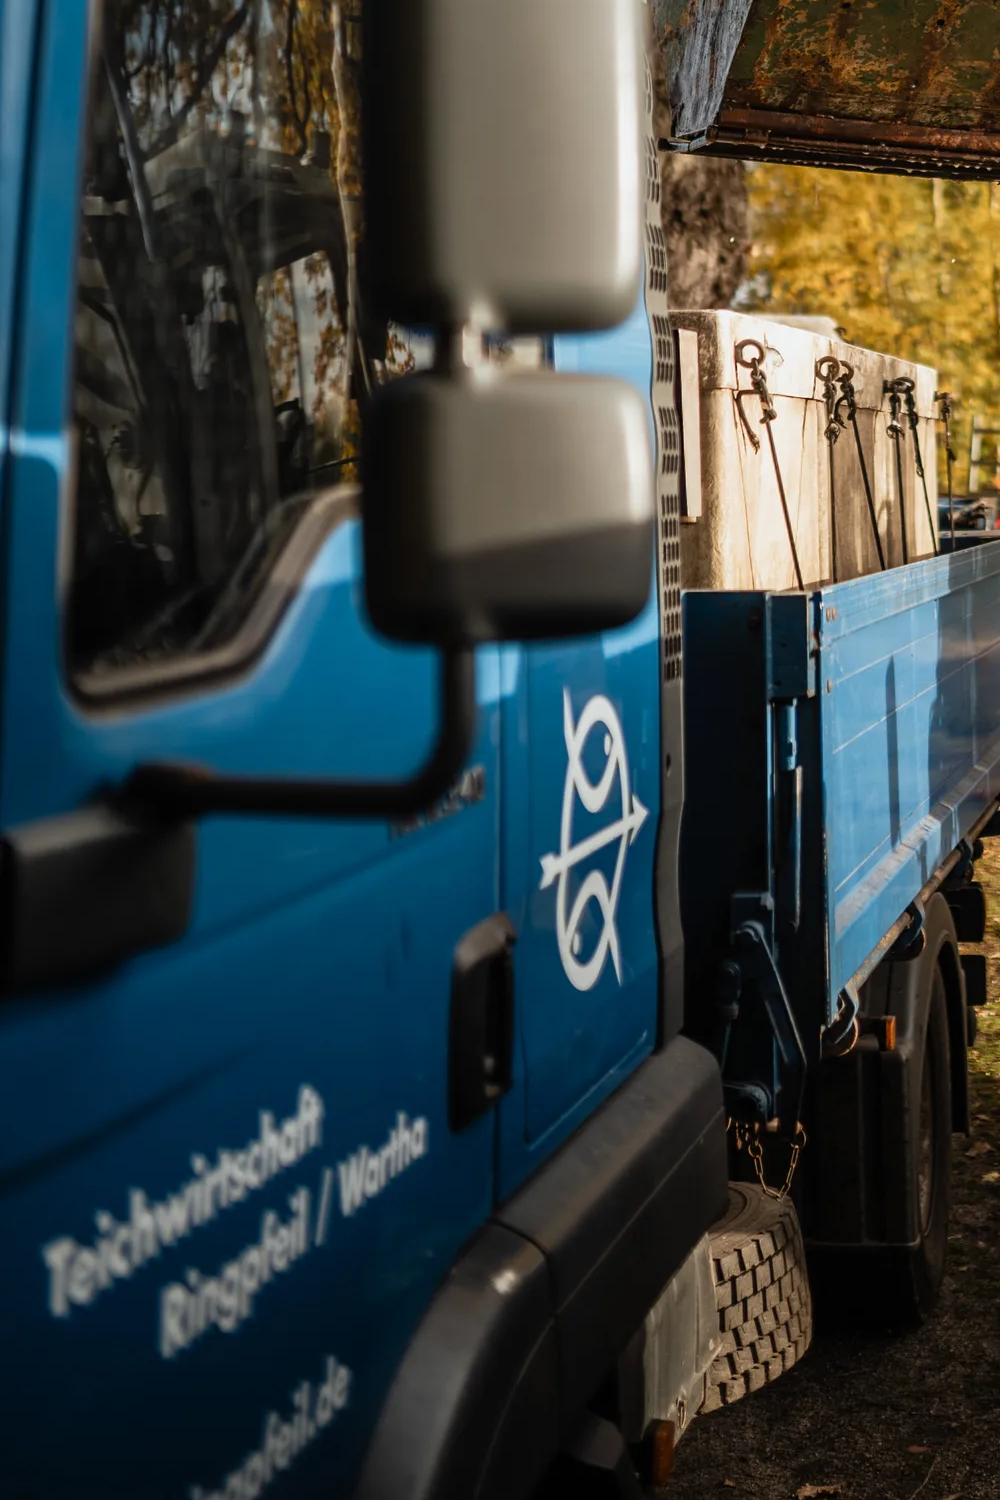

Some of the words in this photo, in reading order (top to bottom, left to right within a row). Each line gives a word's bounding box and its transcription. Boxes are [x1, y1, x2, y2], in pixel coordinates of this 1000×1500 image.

[43, 1083, 324, 1318] Teichwirtschaft
[160, 1187, 311, 1360] Ringpfeil
[336, 1110, 430, 1218] Wartha
